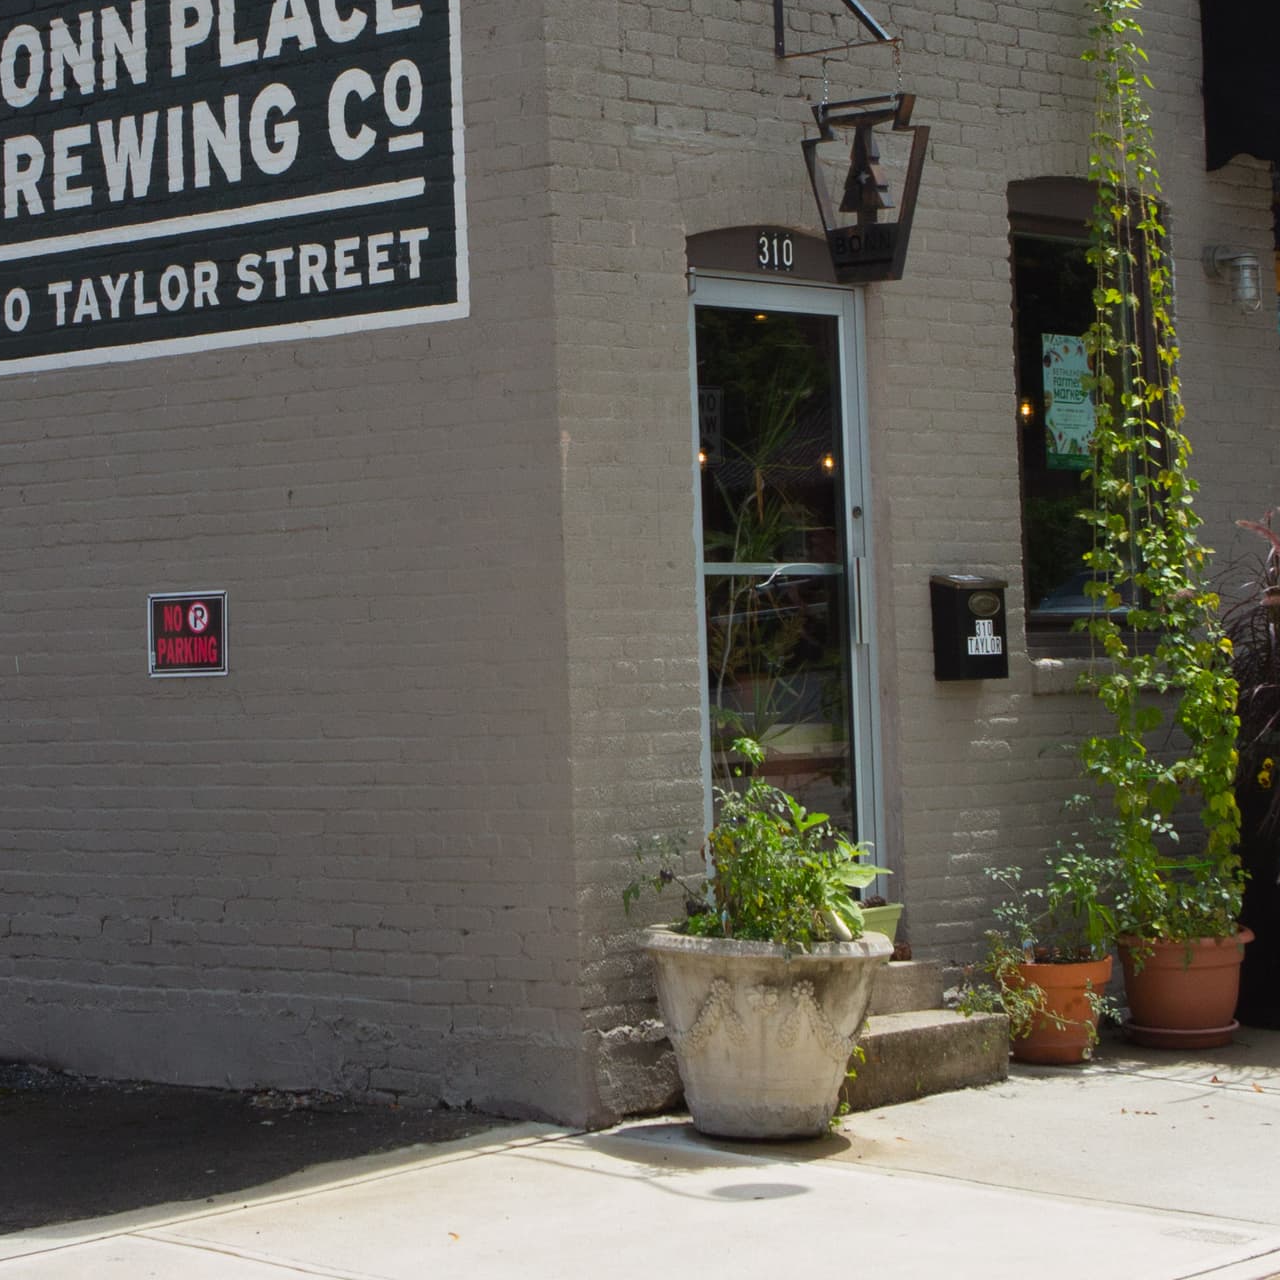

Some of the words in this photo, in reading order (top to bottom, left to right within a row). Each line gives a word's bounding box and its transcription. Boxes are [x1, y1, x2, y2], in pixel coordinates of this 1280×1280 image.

[758, 235, 793, 266] 310
[48, 260, 220, 326] TAYLOR
[236, 226, 430, 301] STREET
[163, 605, 183, 632] NO
[976, 621, 992, 636] 310
[157, 635, 218, 665] PARKING
[968, 637, 1001, 653] TAYLOR
